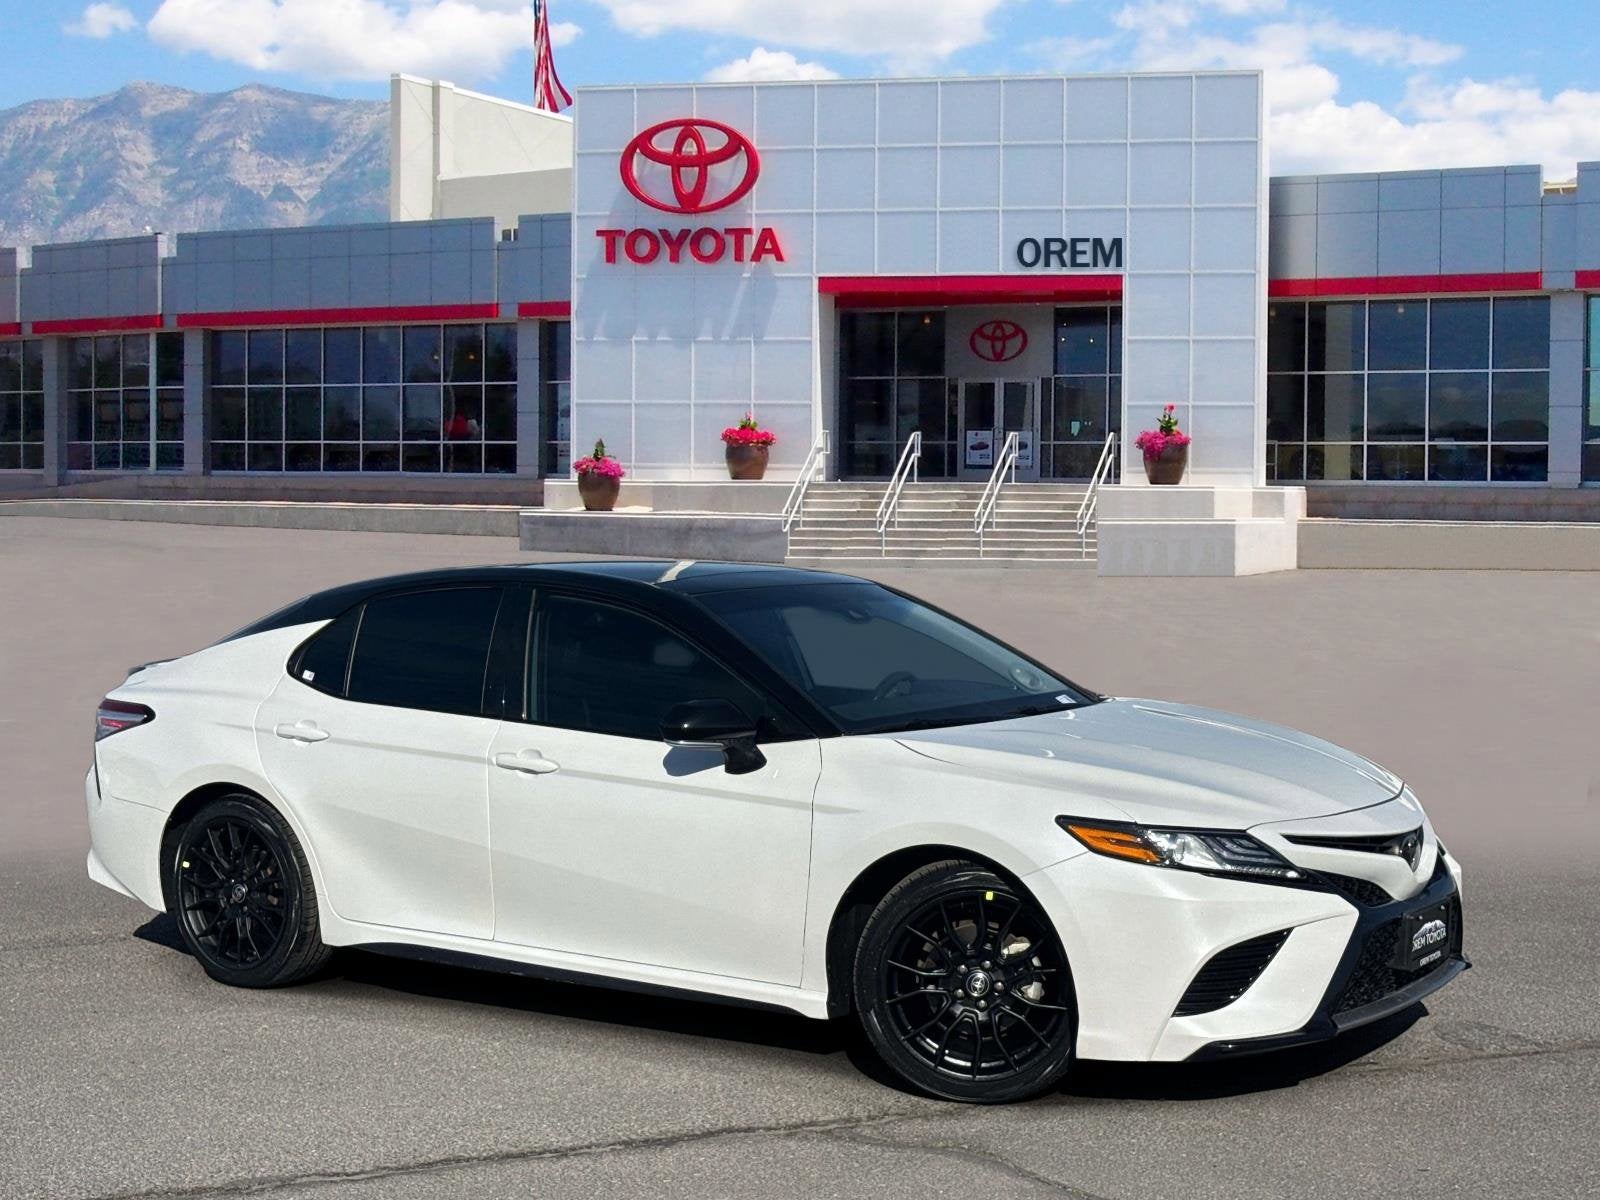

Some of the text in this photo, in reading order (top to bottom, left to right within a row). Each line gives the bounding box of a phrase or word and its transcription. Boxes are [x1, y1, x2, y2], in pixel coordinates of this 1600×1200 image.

[596, 227, 784, 264] TOYOTA
[1017, 237, 1123, 268] OREM
[1426, 927, 1447, 945] TOYOTA
